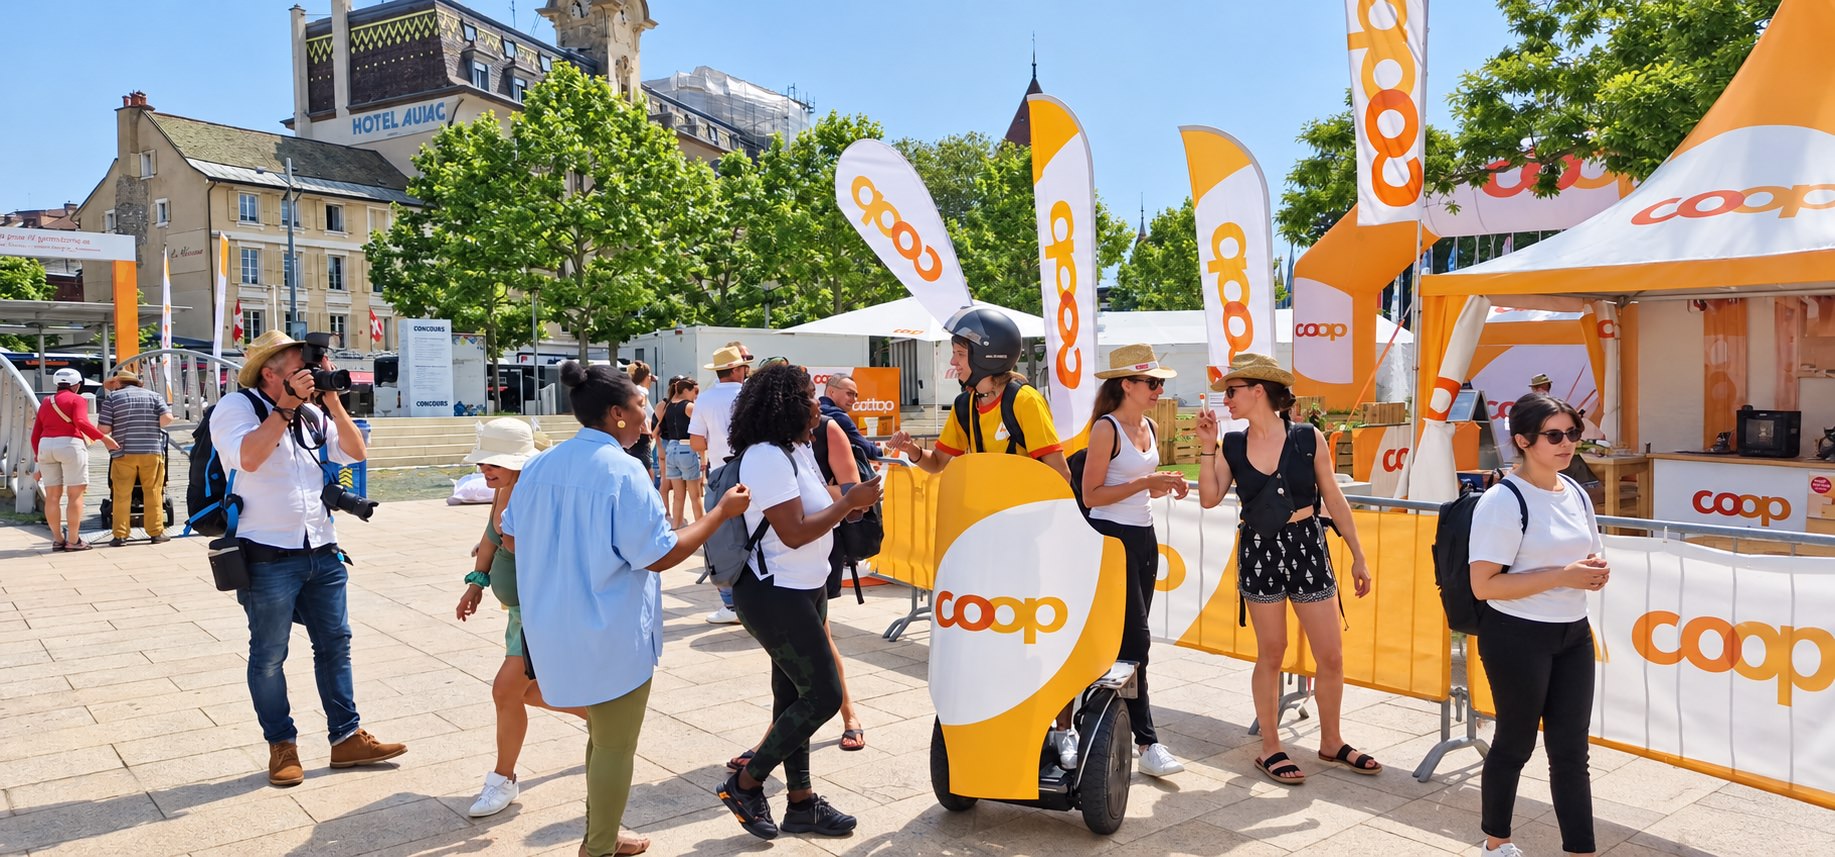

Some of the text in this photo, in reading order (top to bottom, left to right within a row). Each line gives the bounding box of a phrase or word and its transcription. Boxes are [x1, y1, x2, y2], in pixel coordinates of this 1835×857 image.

[352, 110, 399, 135] HOTEL
[1631, 183, 1835, 226] coop
[413, 325, 446, 333] CONCOURS
[1295, 322, 1348, 342] coop
[416, 400, 449, 408] CONCOURS
[1692, 489, 1792, 527] coop
[935, 590, 1069, 645] coop
[1631, 610, 1835, 708] coop
